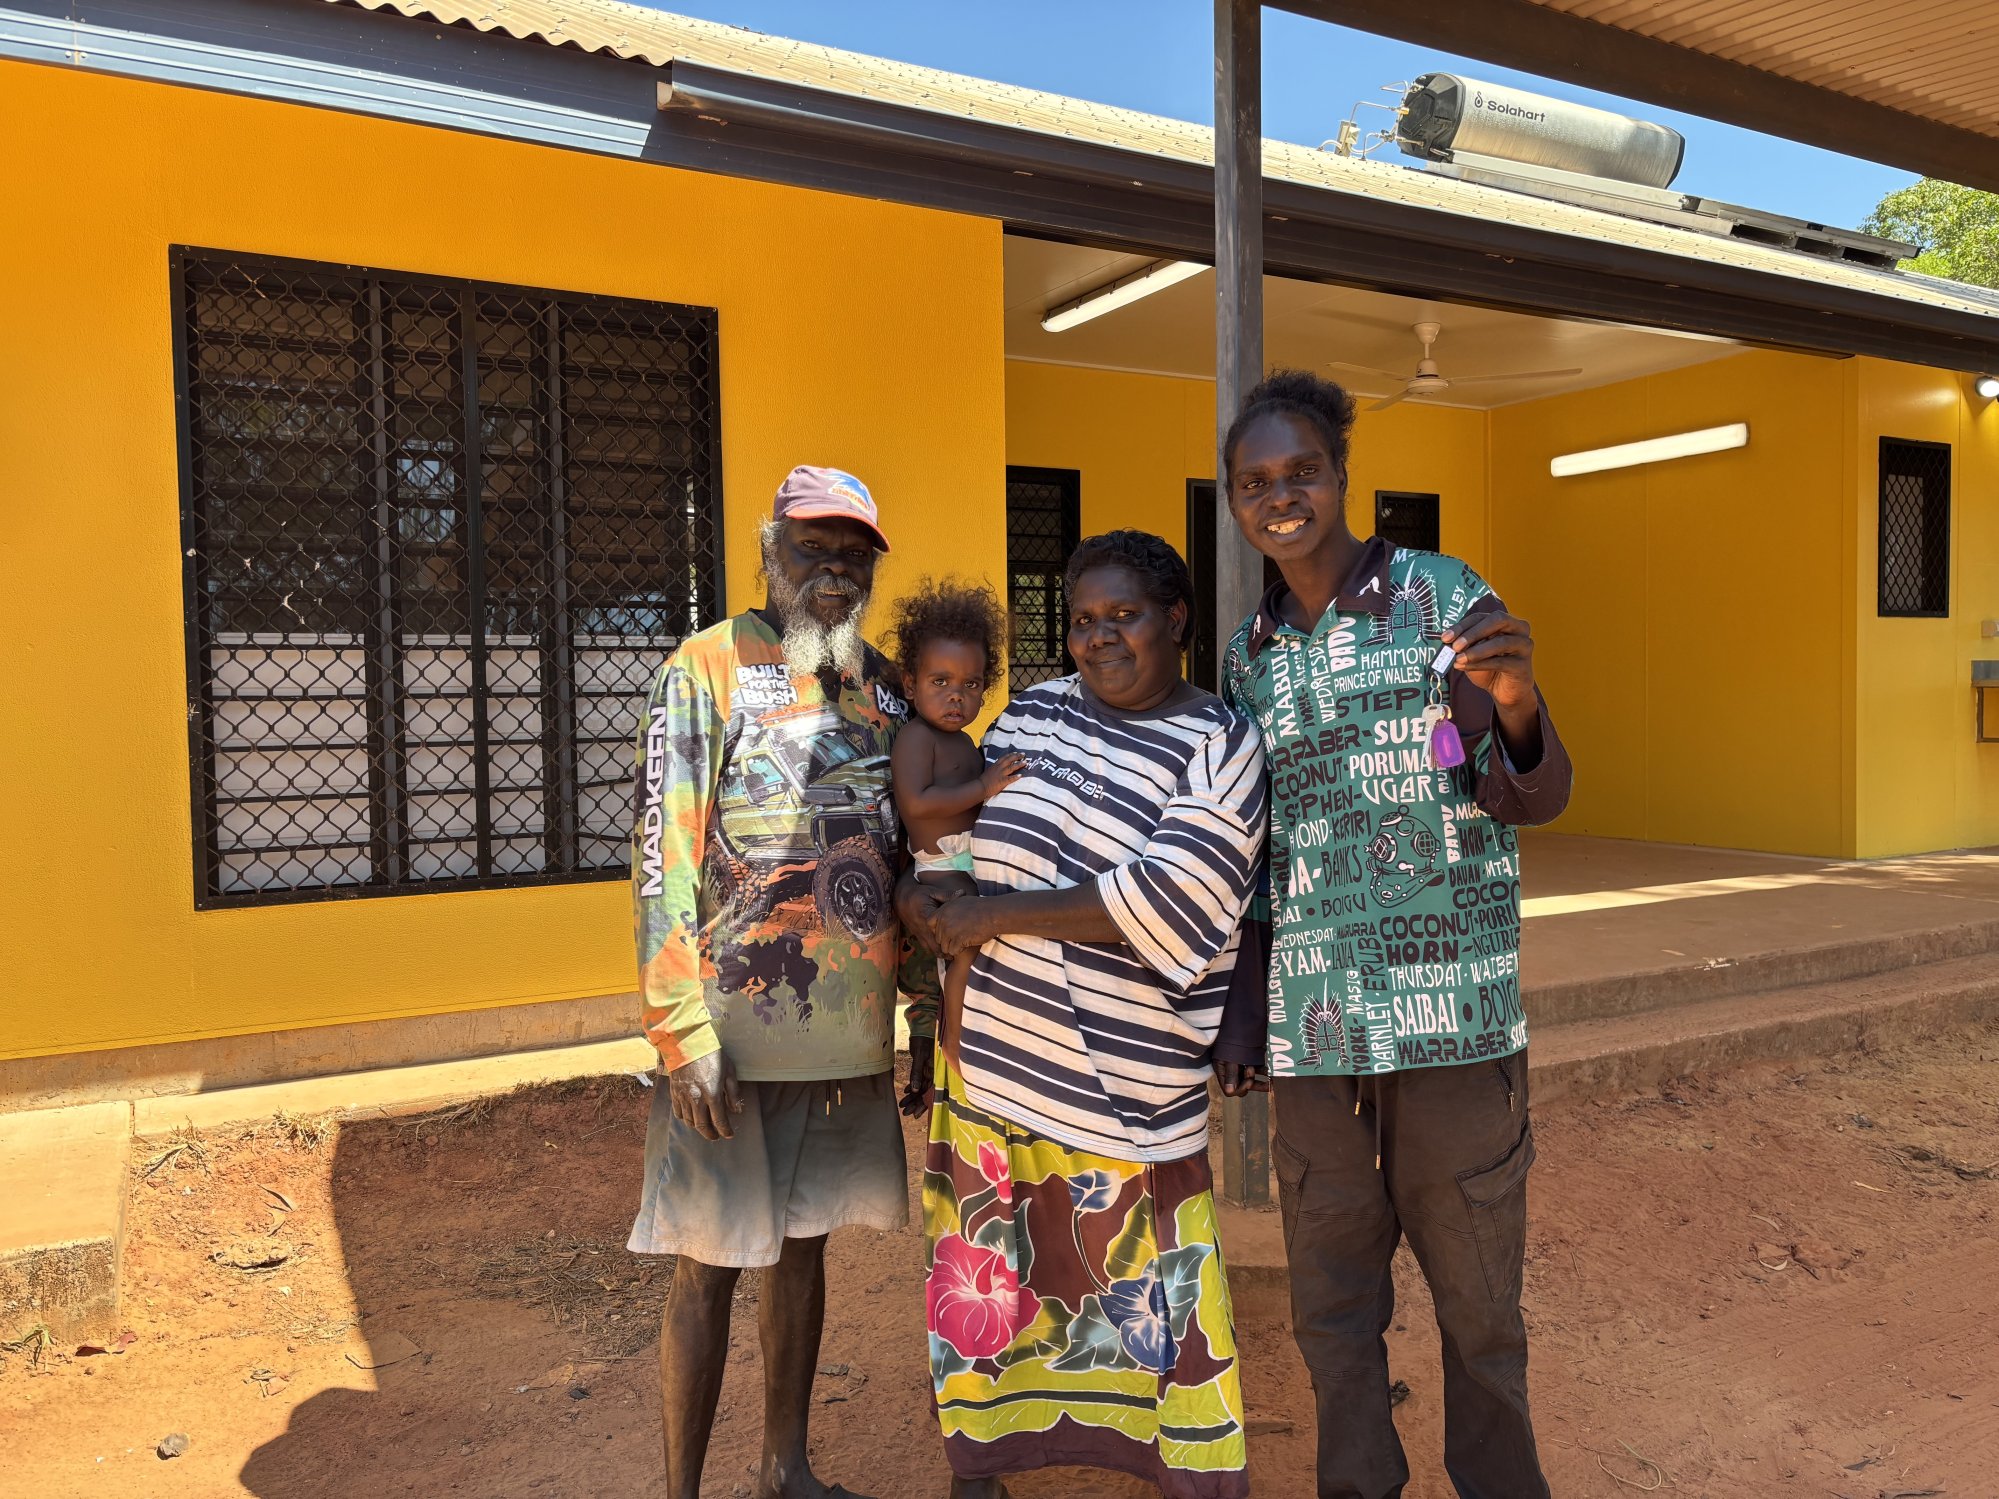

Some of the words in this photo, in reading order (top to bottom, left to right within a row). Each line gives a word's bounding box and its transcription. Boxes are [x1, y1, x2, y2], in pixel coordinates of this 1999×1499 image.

[1487, 100, 1546, 123] Solahart
[1361, 647, 1437, 670] HAMMOND
[735, 663, 790, 685] BUILT
[1334, 672, 1366, 694] PRINCE
[1368, 670, 1382, 687] OF
[740, 685, 799, 706] BUSH
[641, 707, 667, 897] MADKEEN
[1321, 844, 1362, 888] BANKS
[1379, 910, 1475, 942] COCONUT
[1386, 939, 1459, 967] HORN
[1388, 963, 1463, 990] THURSDAY
[1346, 970, 1365, 1015] MASIG
[1393, 992, 1459, 1038] SAIBAI
[1350, 1025, 1372, 1074] YORKE
[1365, 1001, 1395, 1073] DARNLEY
